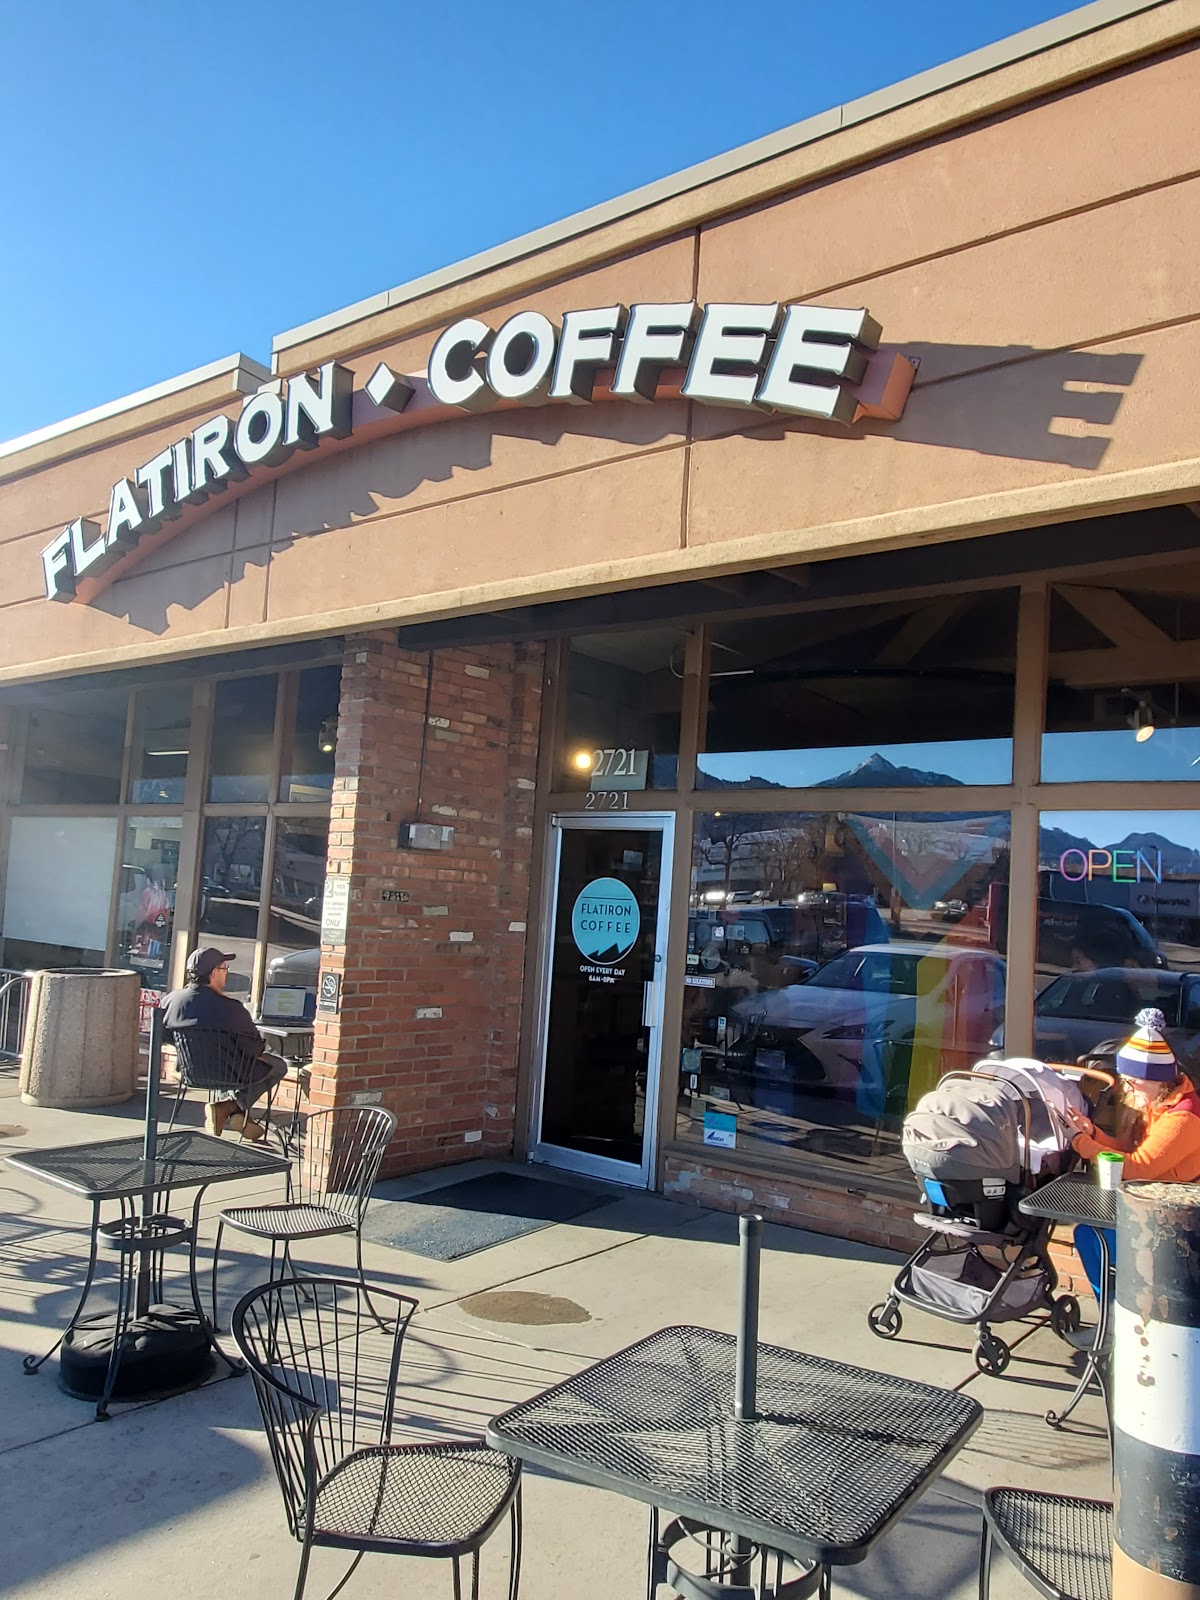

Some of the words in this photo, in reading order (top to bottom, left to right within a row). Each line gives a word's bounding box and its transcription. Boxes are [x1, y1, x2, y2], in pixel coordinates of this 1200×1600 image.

[41, 360, 349, 601] FLATIRON
[427, 300, 869, 420] COFFEE
[591, 748, 637, 776] 2721
[584, 791, 629, 810] 2721
[1060, 848, 1162, 884] OPEN
[581, 903, 632, 917] FLATIRON
[580, 919, 631, 934] COFFEE
[579, 965, 595, 973] OPEN
[595, 966, 613, 976] EVERY
[613, 968, 626, 976] DAY
